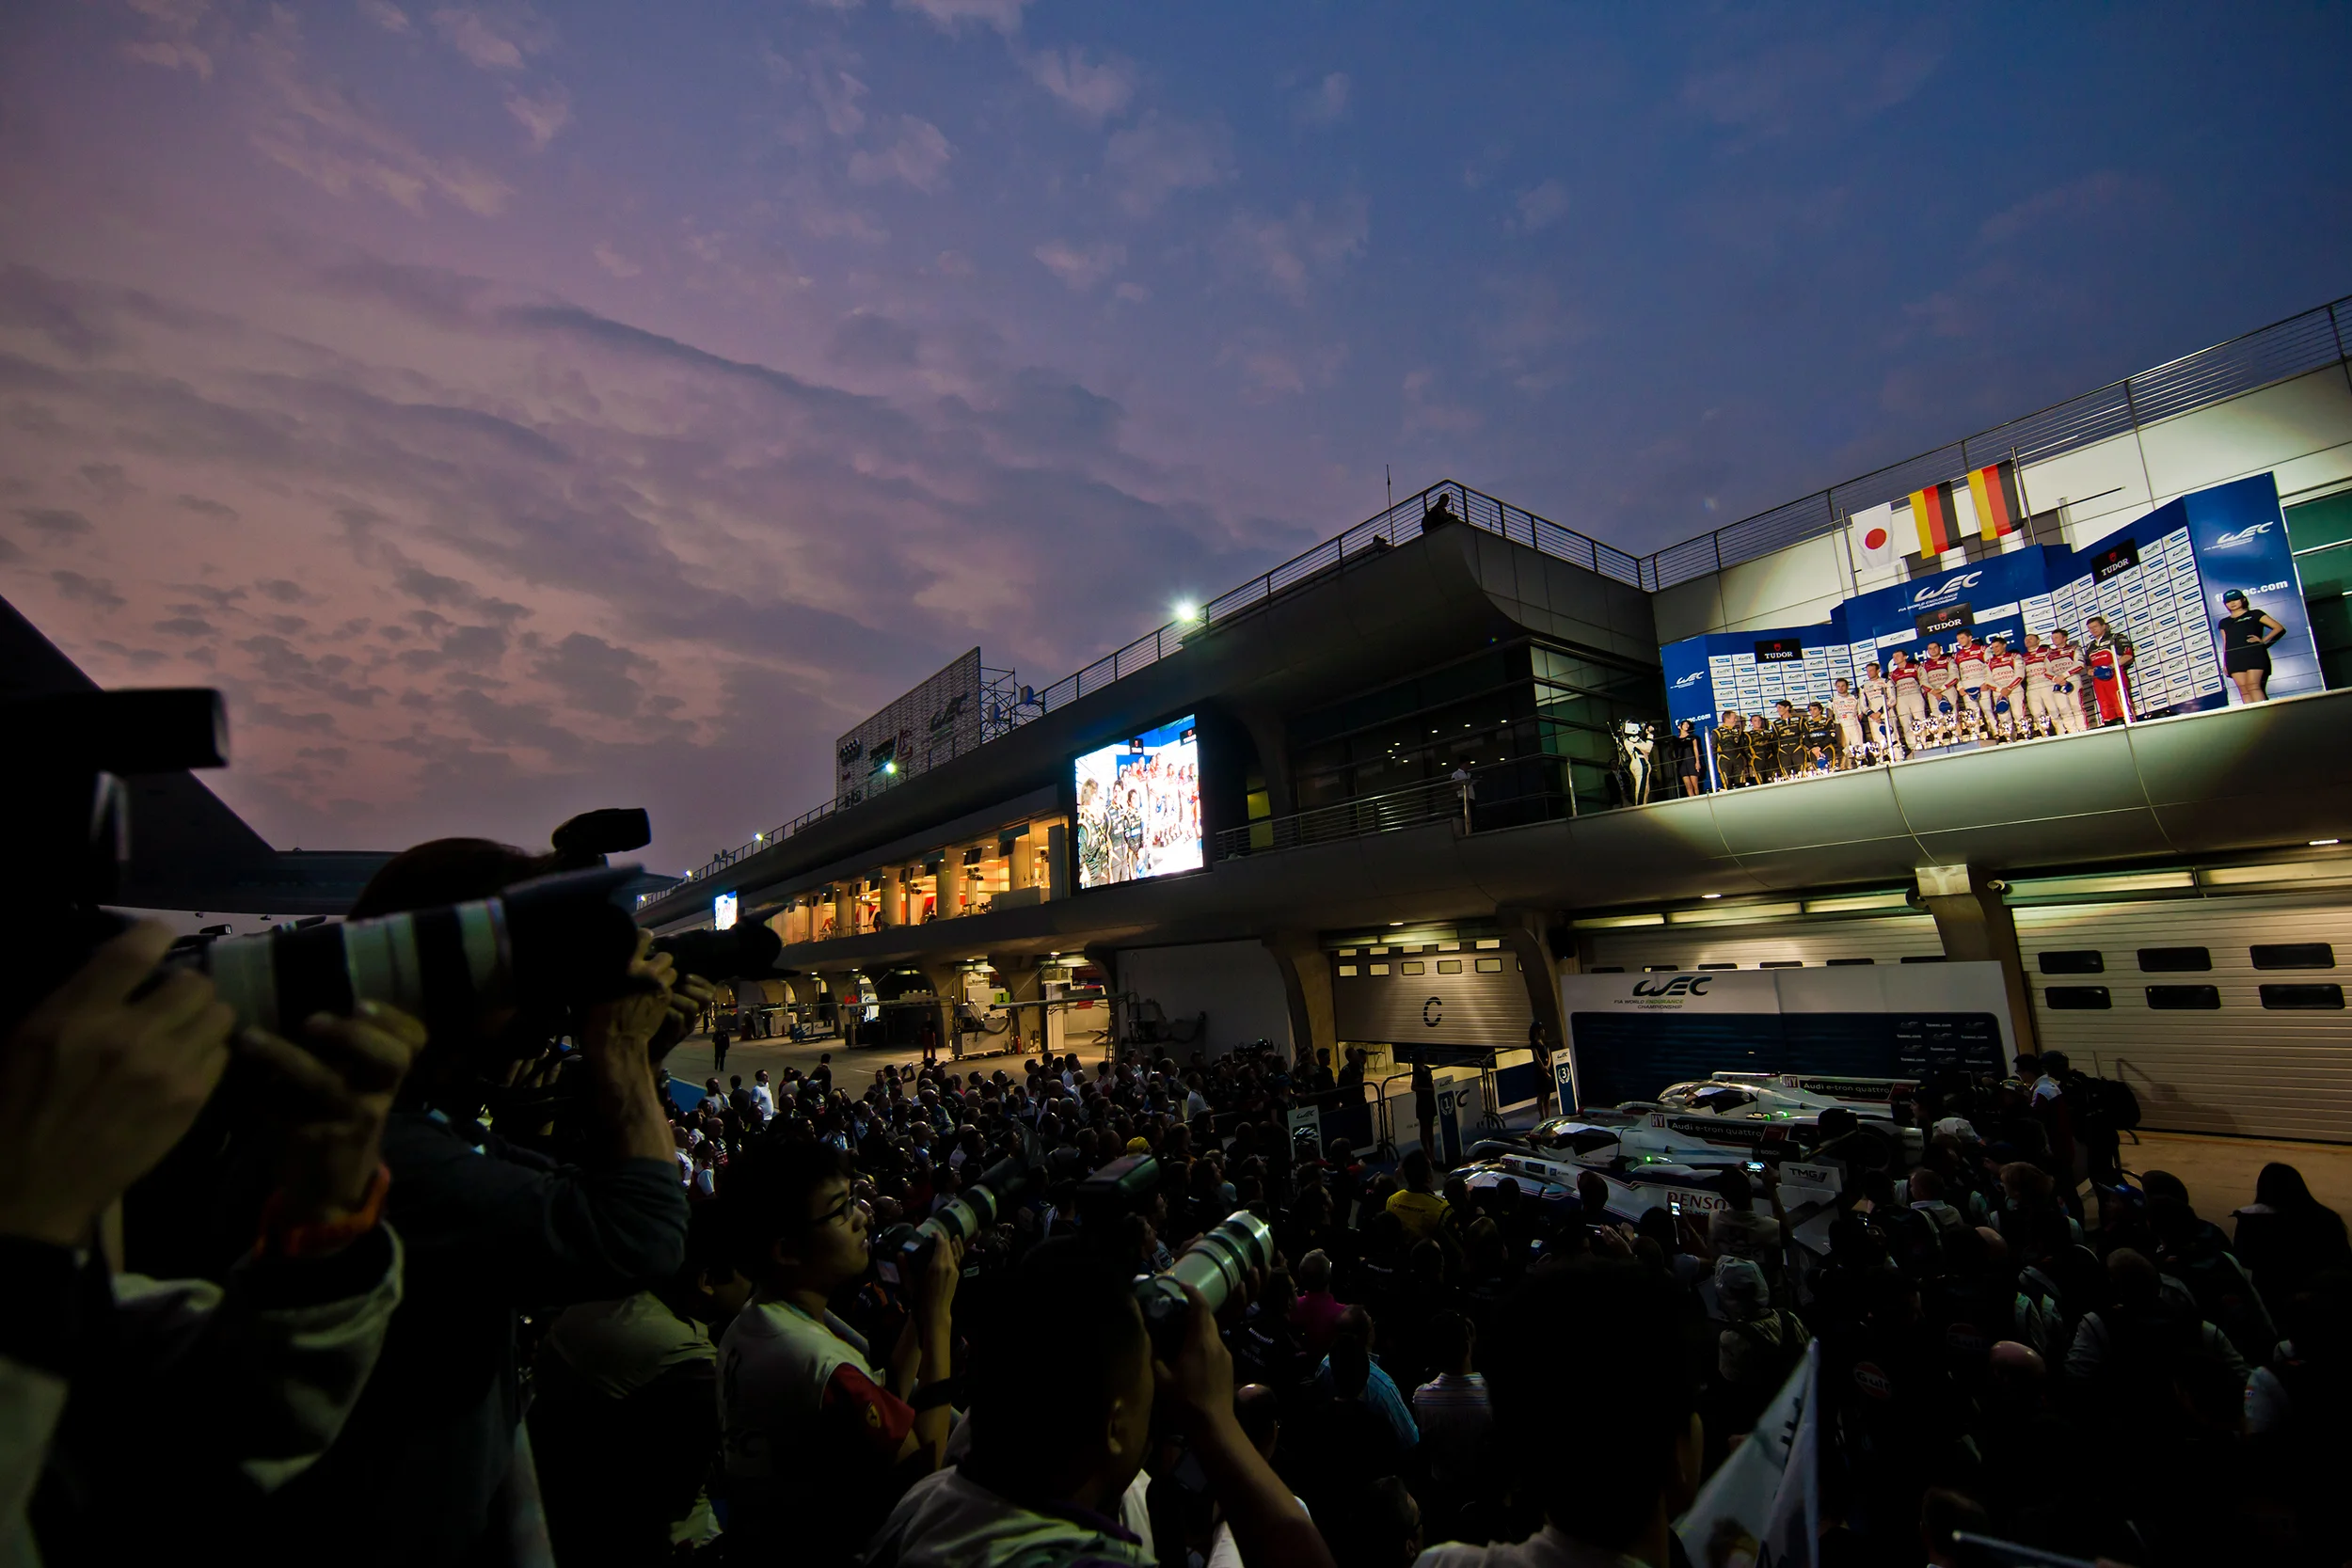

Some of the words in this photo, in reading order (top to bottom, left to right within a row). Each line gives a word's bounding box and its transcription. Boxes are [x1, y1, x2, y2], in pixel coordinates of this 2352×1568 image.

[2217, 521, 2274, 545] WEC
[2101, 558, 2129, 577] TUDOR
[1914, 570, 1983, 603] WEC
[1927, 618, 1963, 632] TUDOR
[1764, 651, 1793, 659] TUDOR
[1677, 671, 1705, 685] WEC
[1632, 976, 1712, 997] WEC
[1422, 996, 1442, 1028] C
[1562, 1067, 1567, 1079] 3
[1785, 1076, 1797, 1087] HY
[1804, 1082, 1825, 1091] Audi
[1826, 1084, 1853, 1092] e-tron
[1855, 1085, 1889, 1095] quattro
[1651, 1114, 1664, 1127] HY
[1671, 1122, 1693, 1131] Audi
[1695, 1124, 1724, 1133] e-tron
[1725, 1128, 1762, 1138] quattro
[1788, 1167, 1818, 1178] TMG
[1667, 1192, 1726, 1210] DENSO
